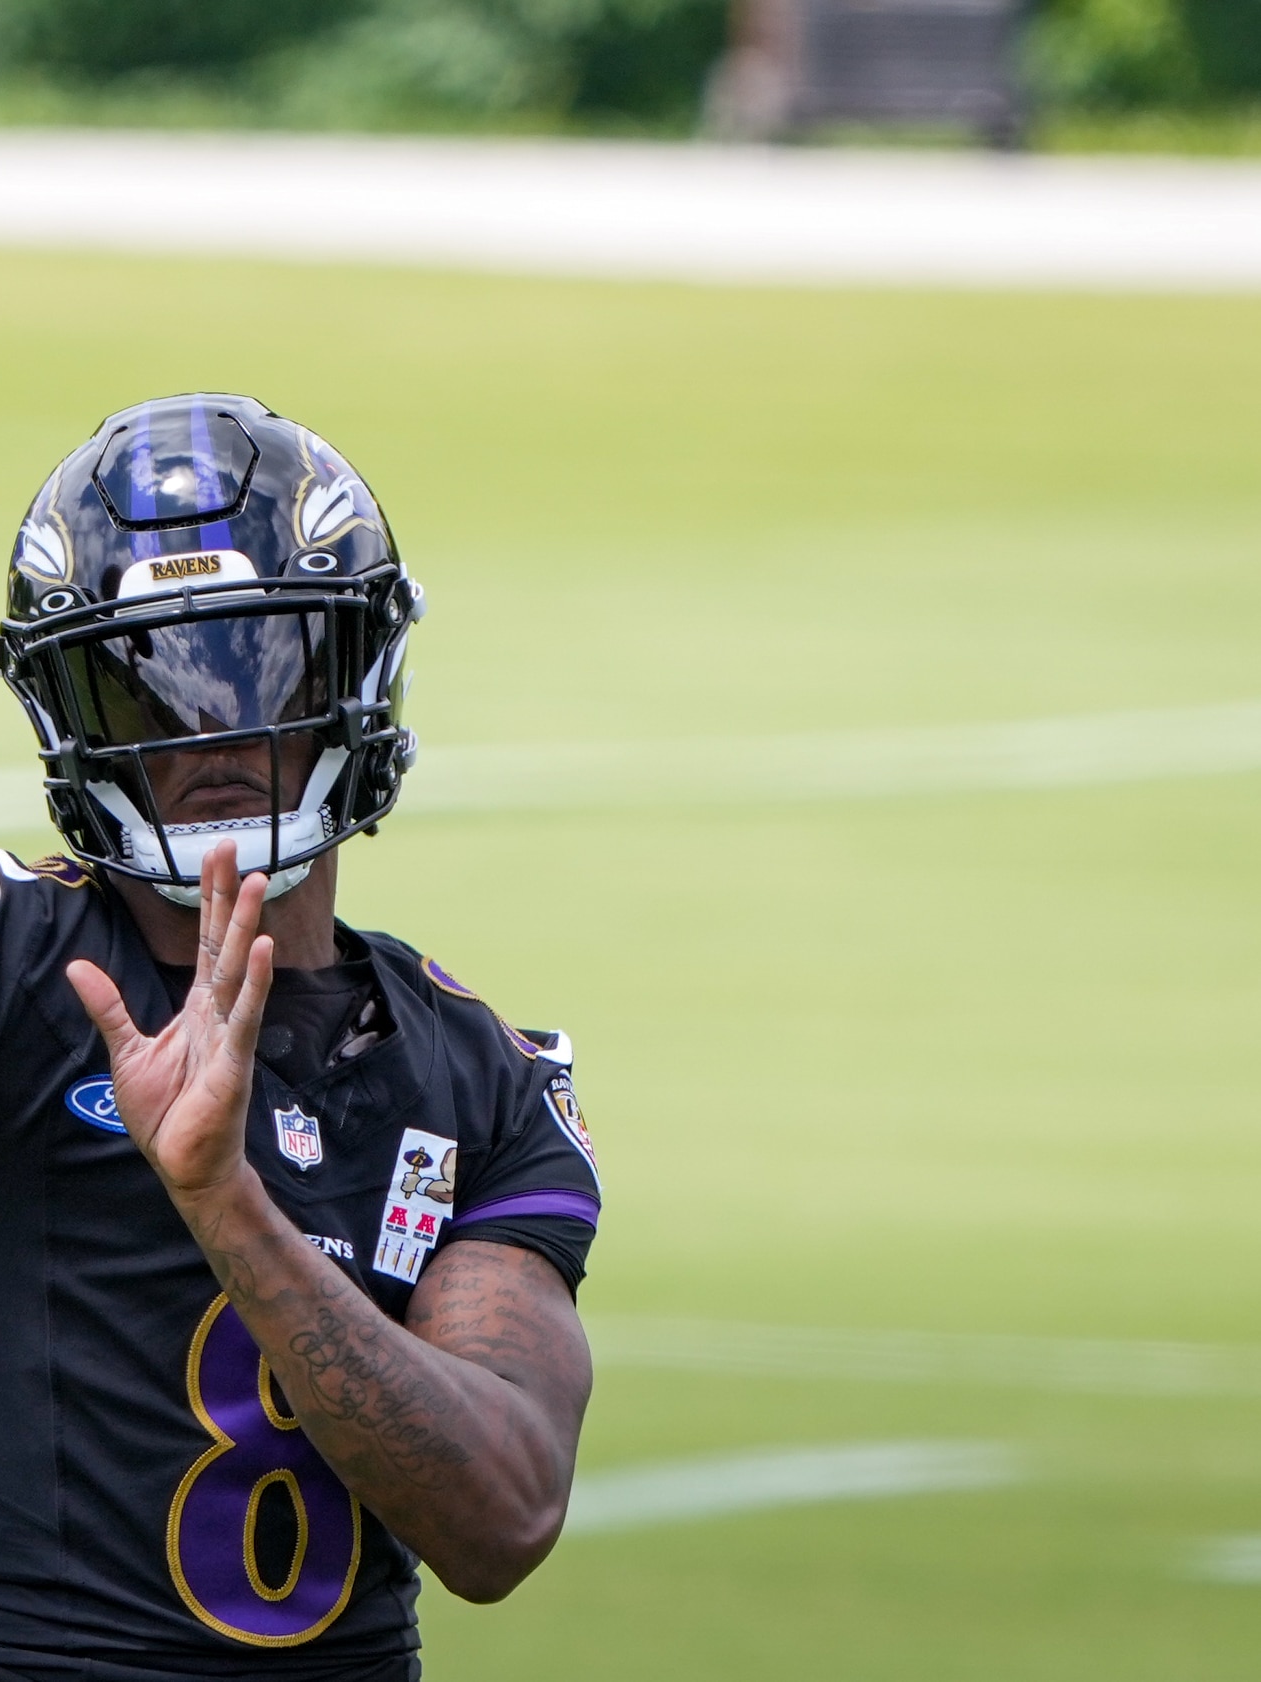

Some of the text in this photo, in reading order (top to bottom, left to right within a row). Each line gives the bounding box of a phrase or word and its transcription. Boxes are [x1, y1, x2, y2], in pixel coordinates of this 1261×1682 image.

[149, 555, 221, 580] RAVENS
[287, 1132, 316, 1157] NFL
[166, 1291, 362, 1648] 8
